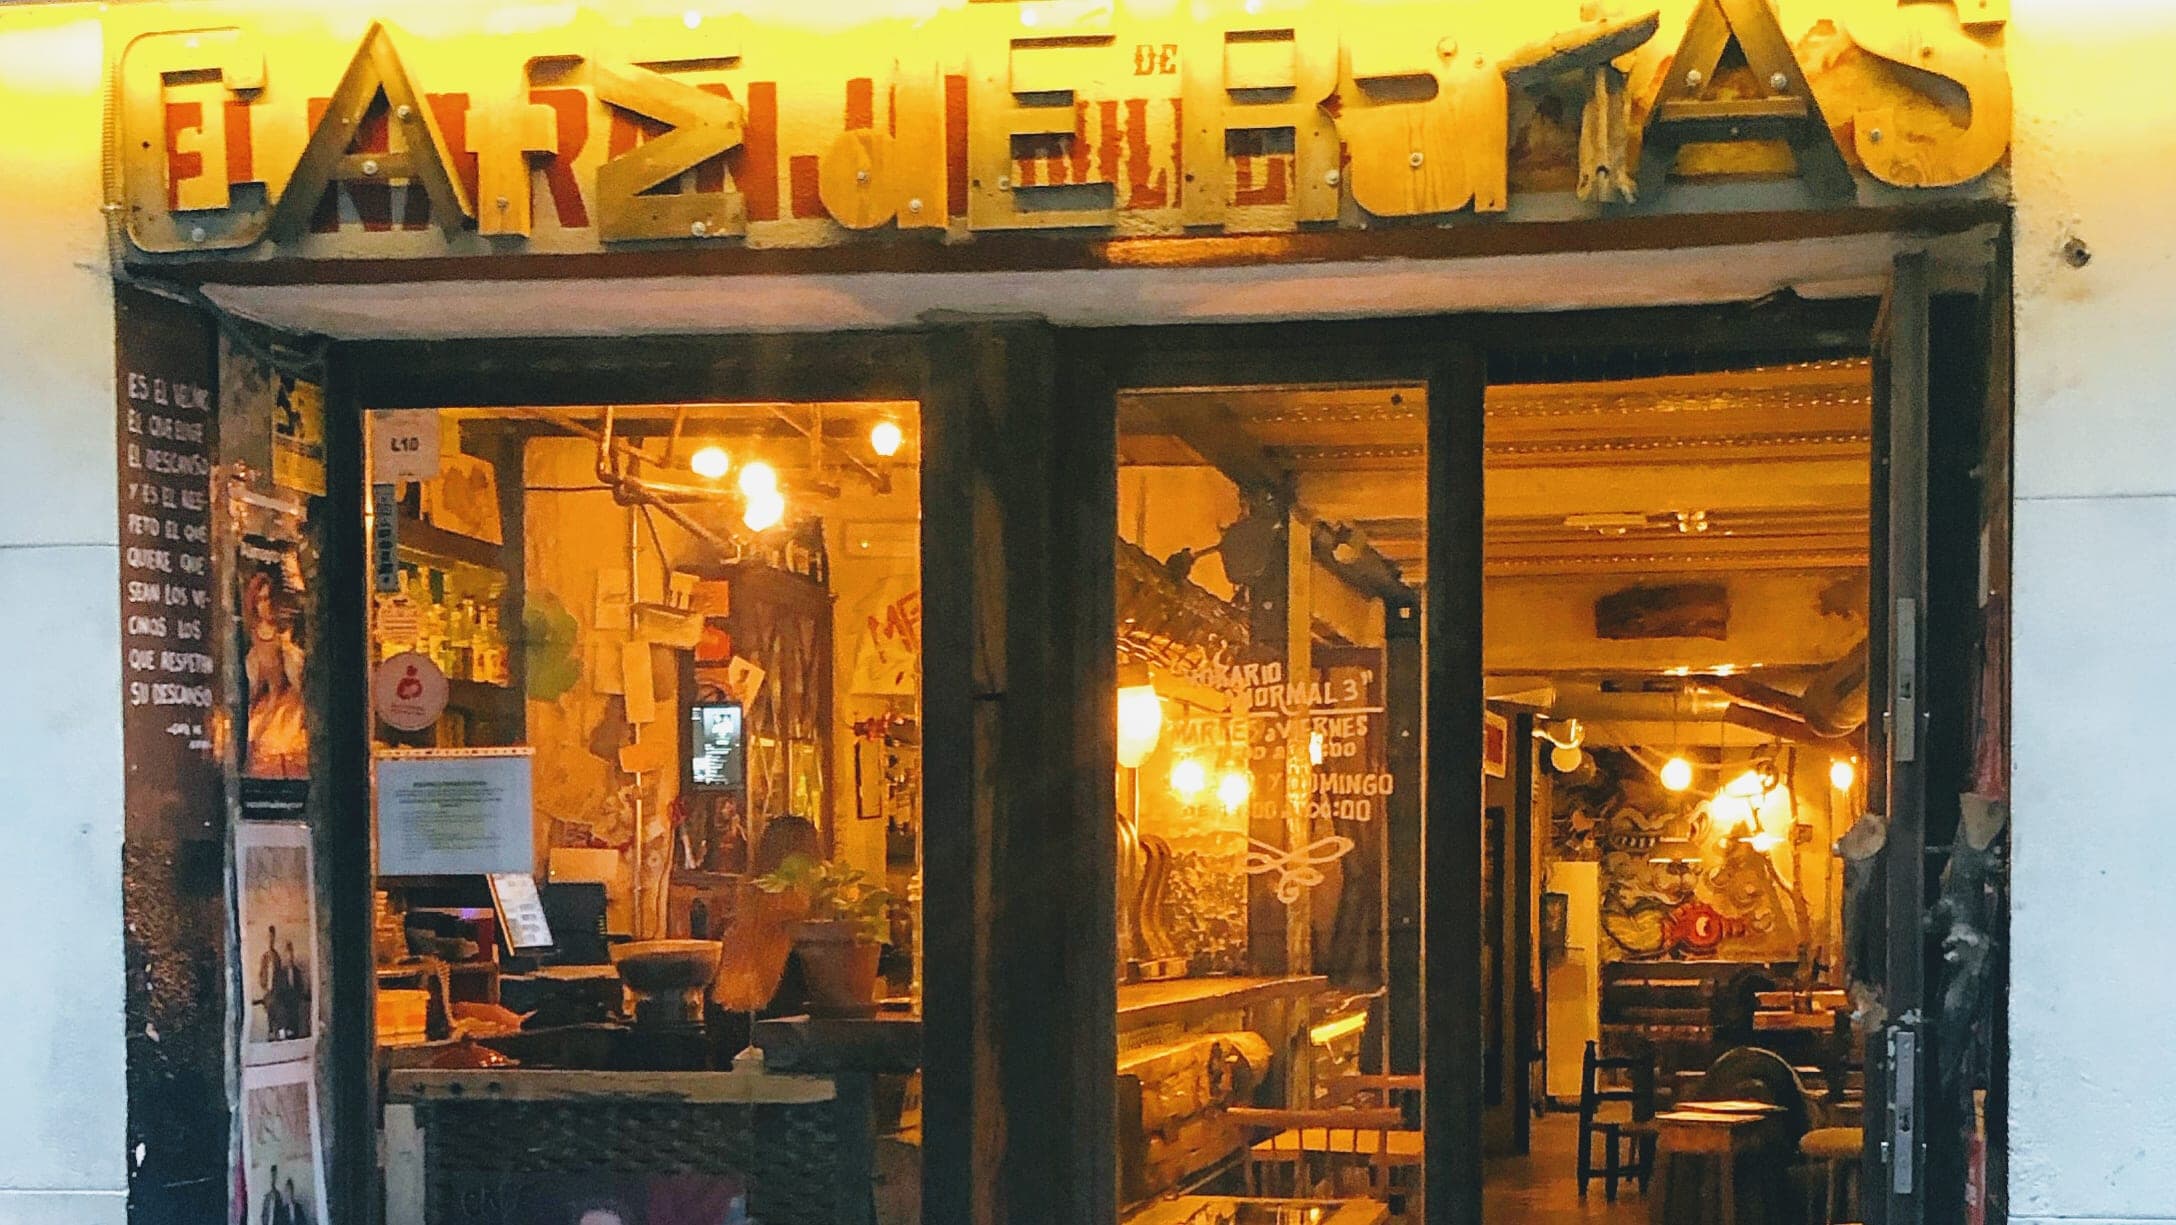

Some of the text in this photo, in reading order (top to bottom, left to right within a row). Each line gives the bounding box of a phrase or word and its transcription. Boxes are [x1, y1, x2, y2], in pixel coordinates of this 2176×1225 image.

[1133, 44, 1178, 76] DE
[127, 372, 149, 400] ES
[153, 378, 169, 406] EL
[127, 443, 143, 469] EL
[128, 483, 139, 500] Y
[165, 583, 188, 606] LOS
[177, 618, 202, 640] LOS
[128, 648, 155, 671] QUE
[130, 681, 149, 705] SU
